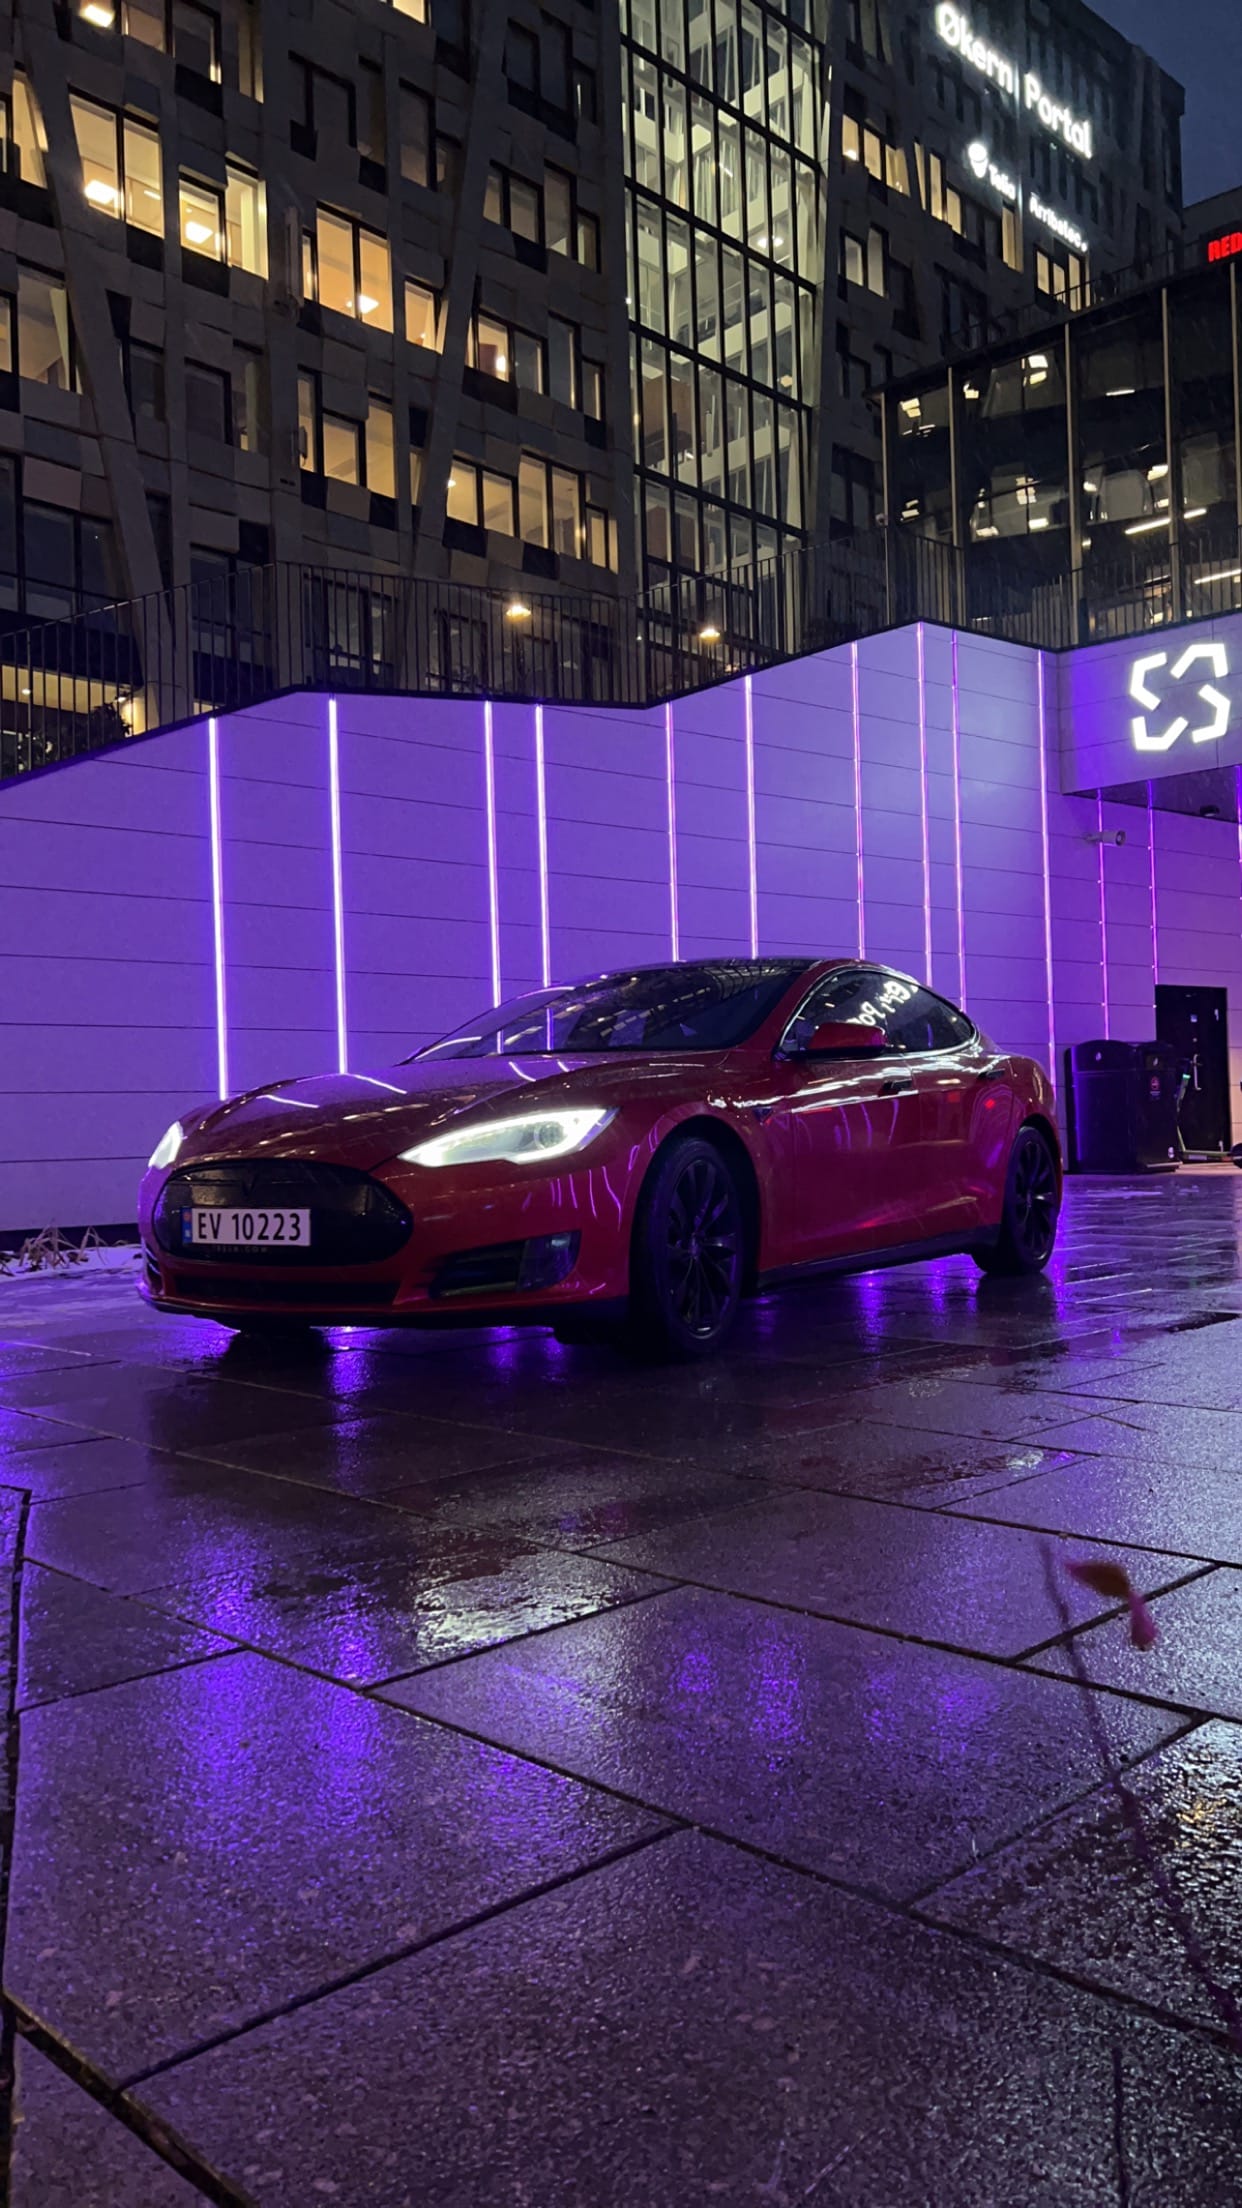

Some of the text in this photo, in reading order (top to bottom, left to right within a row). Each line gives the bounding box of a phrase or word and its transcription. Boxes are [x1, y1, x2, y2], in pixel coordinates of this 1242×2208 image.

[935, 3, 1093, 159] Økern Portal
[198, 1213, 301, 1241] EV 10223
